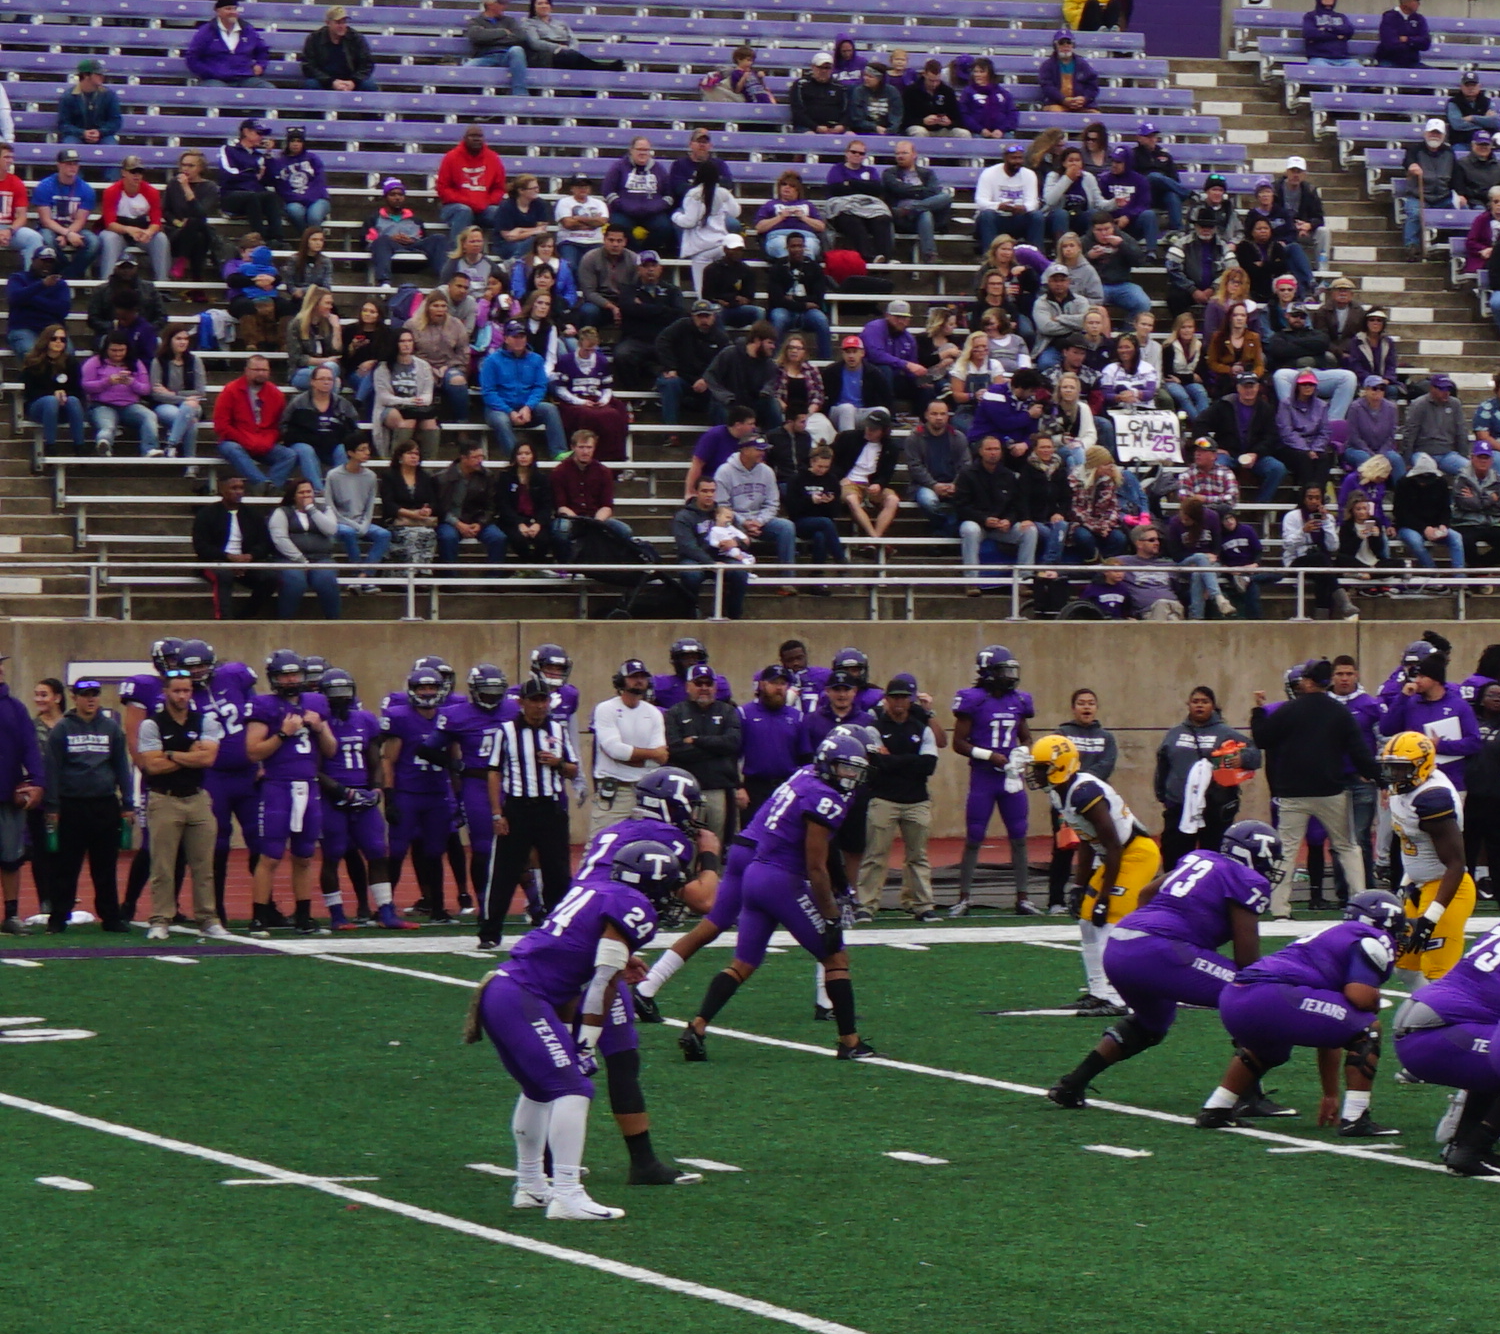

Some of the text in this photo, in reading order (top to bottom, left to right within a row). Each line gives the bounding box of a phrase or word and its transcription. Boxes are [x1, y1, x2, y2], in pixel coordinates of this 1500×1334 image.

[1128, 420, 1175, 435] CALM
[990, 720, 1016, 749] 17
[342, 743, 365, 770] 11
[668, 774, 695, 803] T
[816, 796, 844, 820] 87
[577, 833, 618, 880] 7
[1253, 833, 1275, 858] T
[645, 854, 671, 881] T
[1159, 855, 1214, 898] 73
[1244, 887, 1270, 915] 73
[622, 906, 654, 940] 24
[1191, 957, 1237, 983] TEXANS
[1300, 997, 1347, 1021] TEXANS
[531, 1018, 572, 1069] TEXANS
